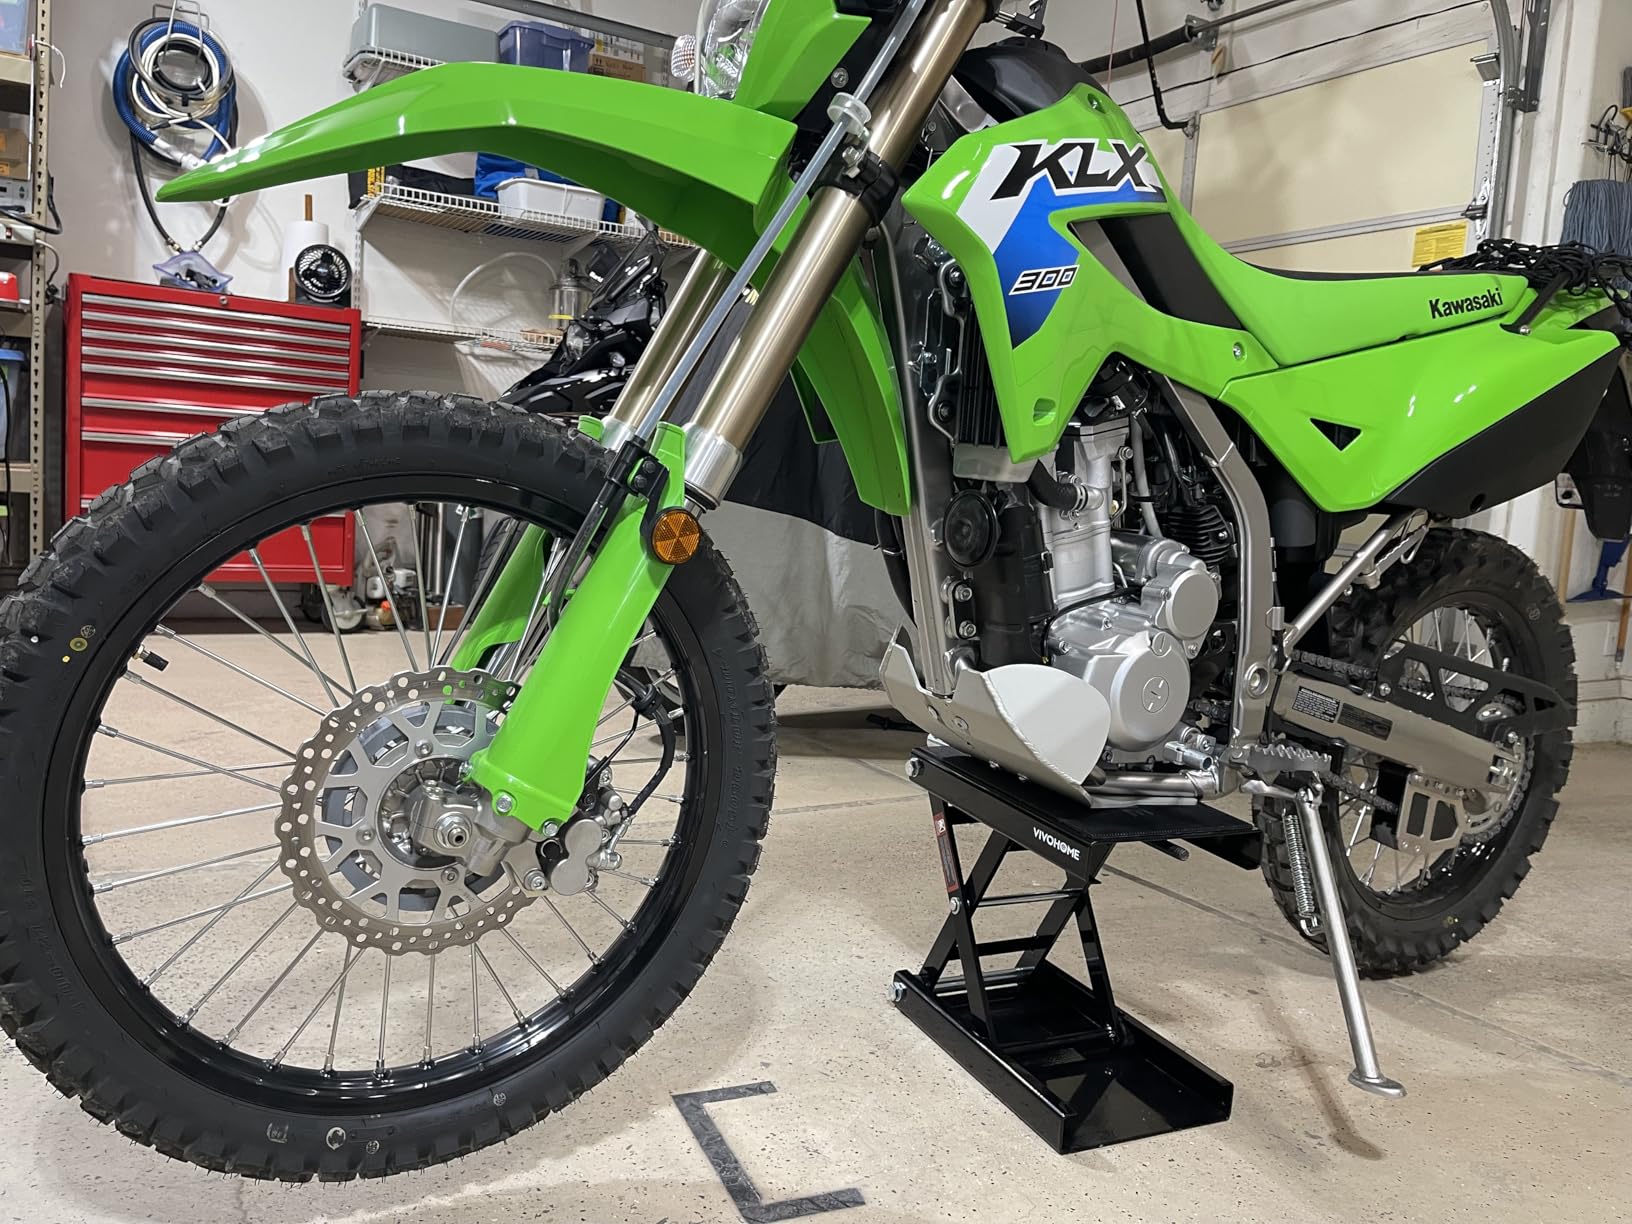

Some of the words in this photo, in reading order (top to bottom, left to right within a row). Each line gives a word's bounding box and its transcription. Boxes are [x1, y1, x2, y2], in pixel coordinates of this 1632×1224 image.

[990, 143, 1147, 200] KLX
[1011, 266, 1078, 293] 300
[1429, 287, 1503, 319] Kawasaki
[1033, 826, 1080, 861] VIVOHOME
